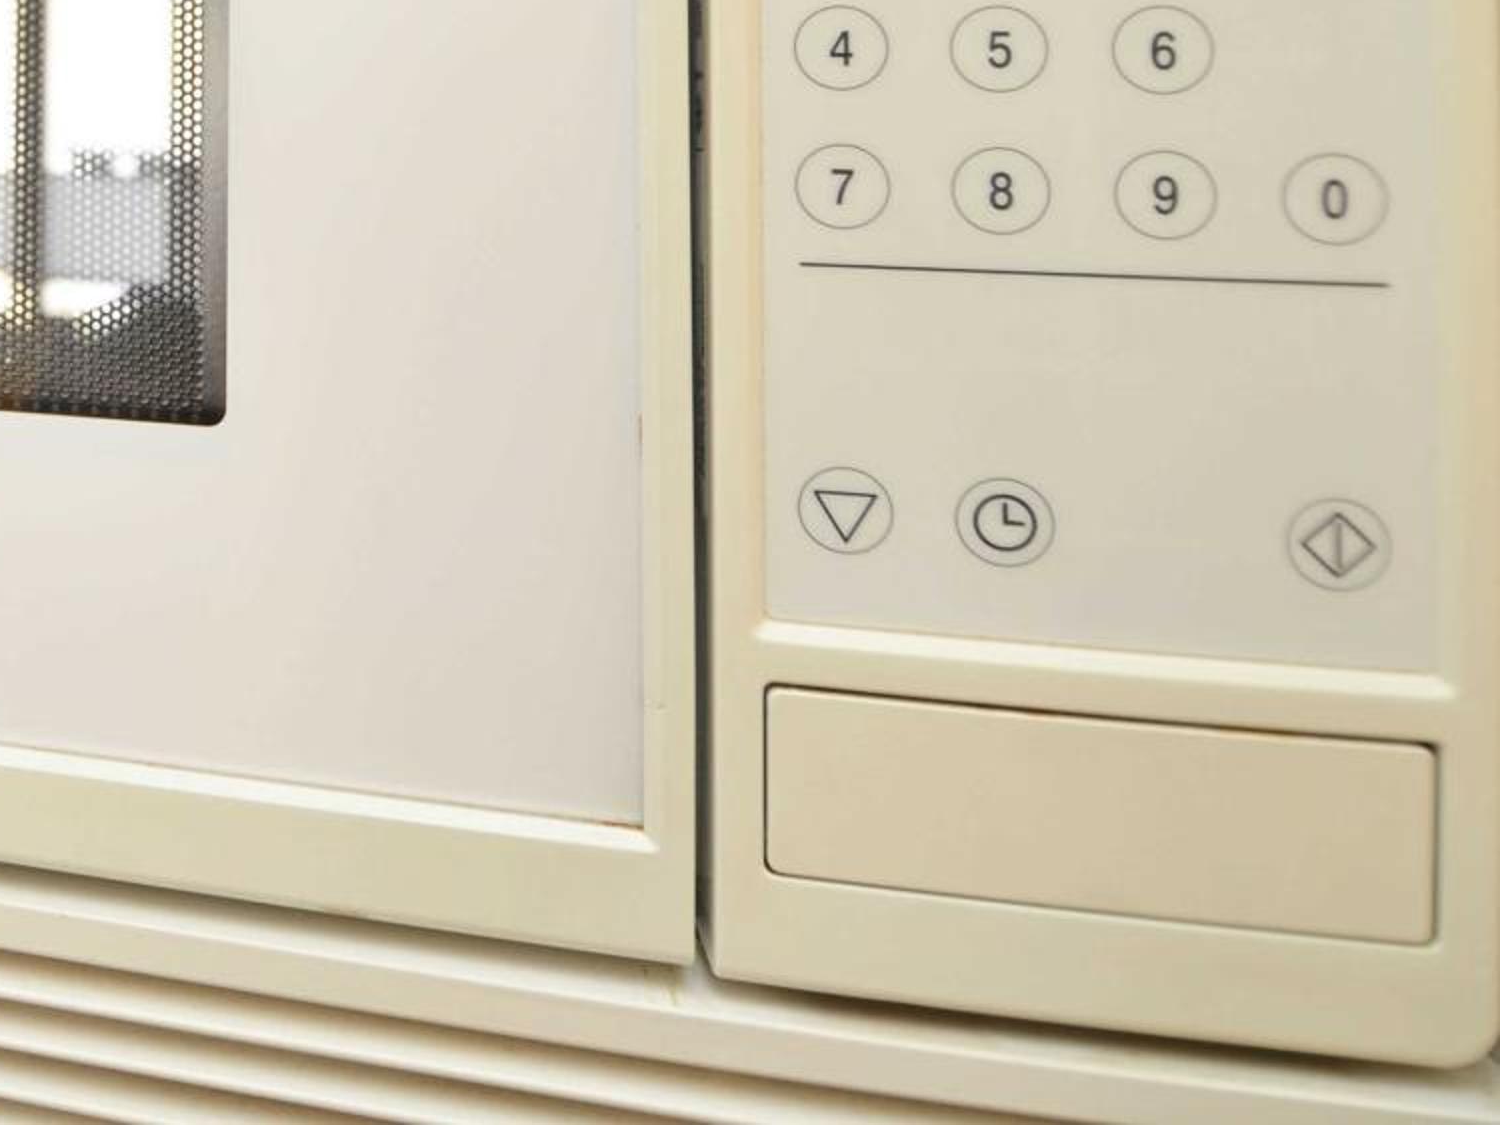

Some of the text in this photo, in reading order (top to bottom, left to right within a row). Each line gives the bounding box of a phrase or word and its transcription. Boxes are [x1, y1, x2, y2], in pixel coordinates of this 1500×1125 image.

[829, 30, 1177, 71] 4 5 6
[830, 168, 1348, 220] 7 8 9 0
